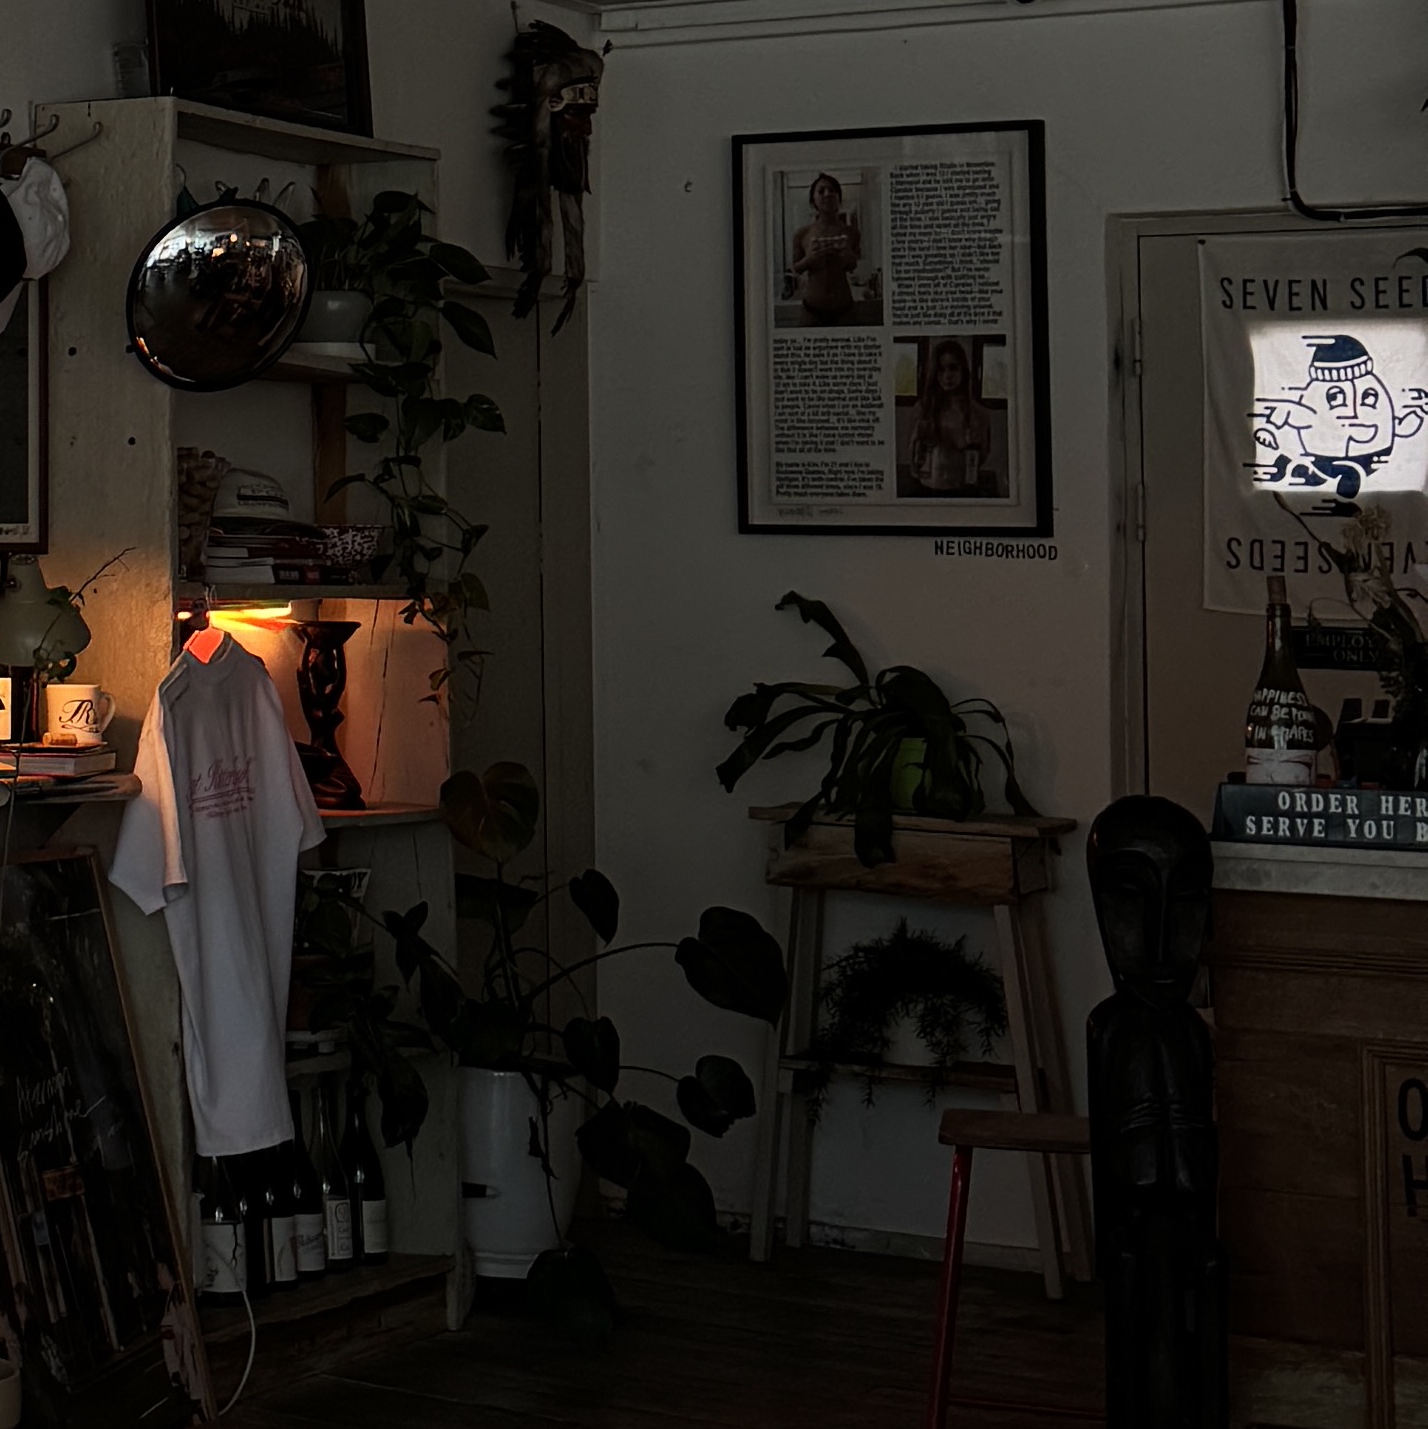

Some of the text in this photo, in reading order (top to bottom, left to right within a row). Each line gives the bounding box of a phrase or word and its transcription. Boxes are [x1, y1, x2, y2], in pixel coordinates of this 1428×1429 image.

[1220, 277, 1328, 311] SEVEN
[934, 540, 1058, 561] NEIGHBORHOOD
[1333, 649, 1380, 663] ONLY
[1277, 790, 1359, 815] ORDER
[1246, 814, 1326, 838] SERVE
[1347, 819, 1395, 840] YOU
